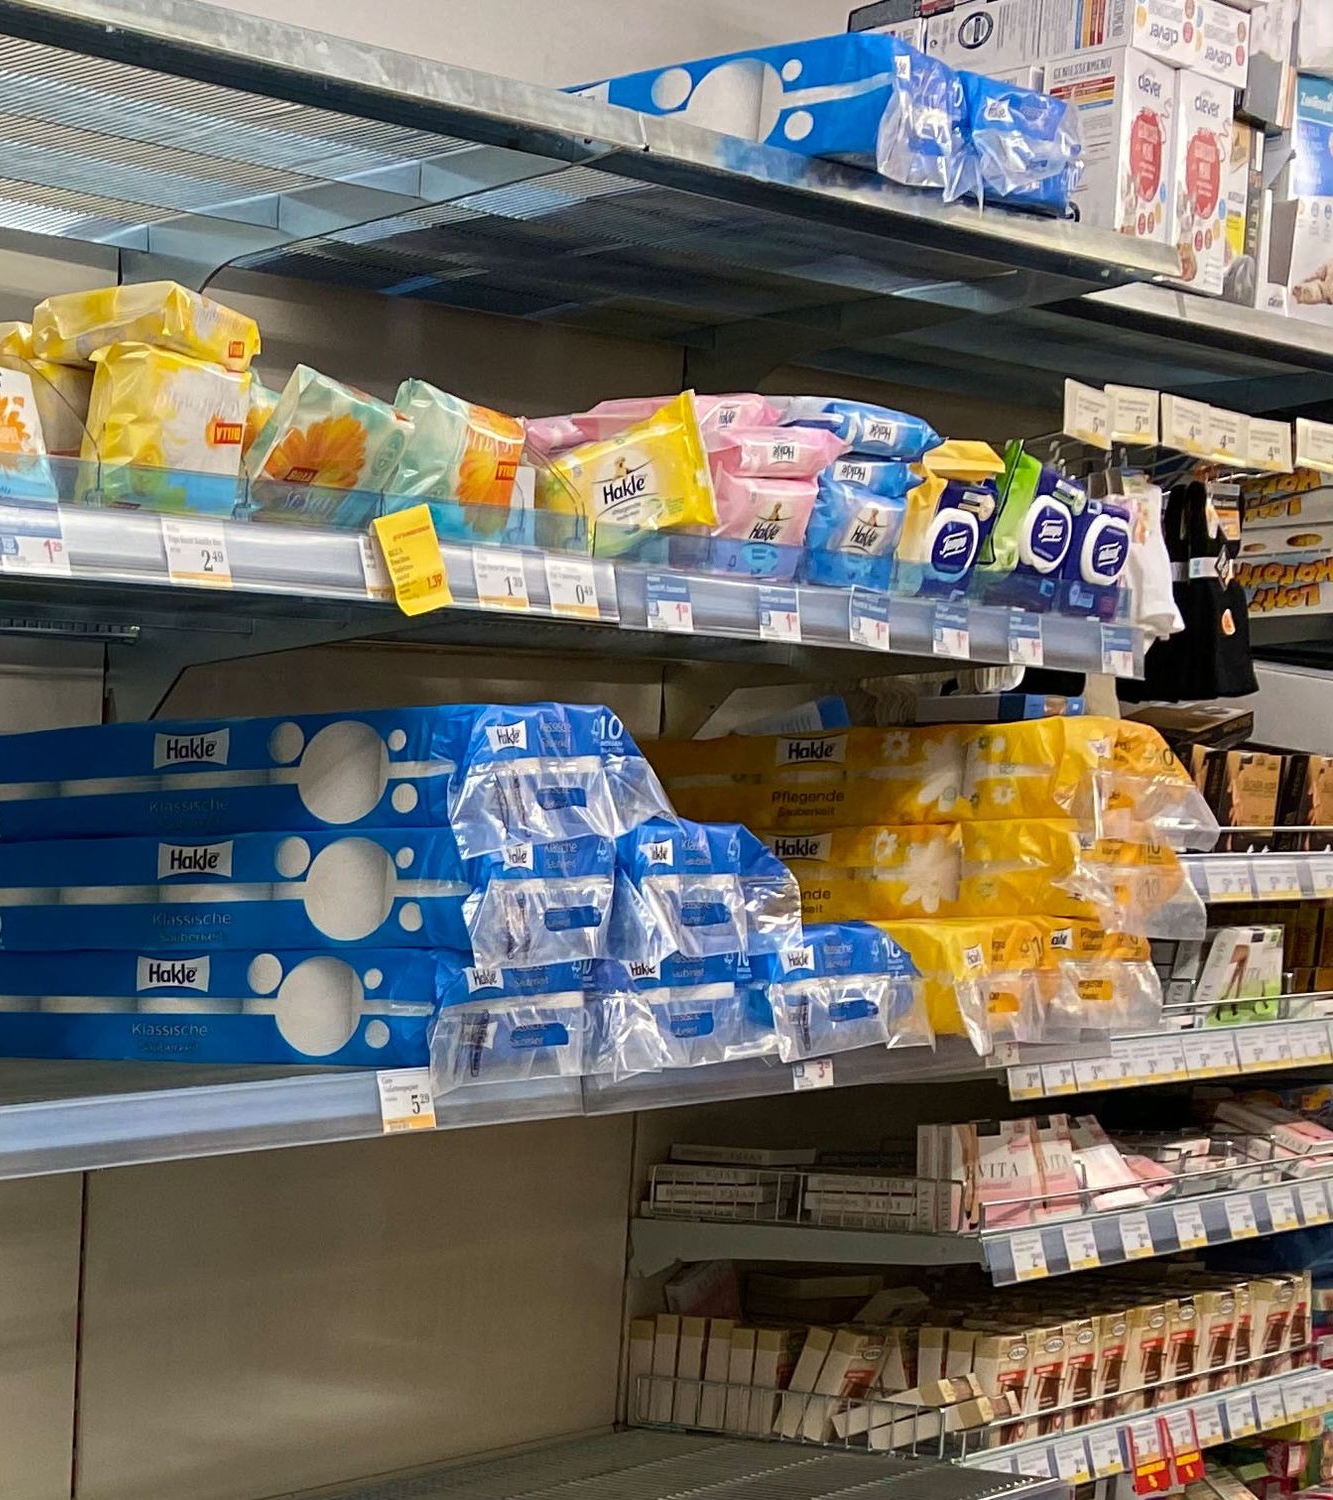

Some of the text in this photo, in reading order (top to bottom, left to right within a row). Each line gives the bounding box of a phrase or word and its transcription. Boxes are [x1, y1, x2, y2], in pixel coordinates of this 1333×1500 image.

[1137, 72, 1162, 99] clever
[1194, 94, 1220, 119] clever
[602, 474, 647, 505] Hakle
[748, 521, 781, 543] Hakle
[851, 525, 879, 548] Hakle
[166, 736, 216, 761] Hakle
[787, 740, 834, 760] Hakle
[150, 797, 229, 814] Klassische
[771, 789, 845, 805] Pflegende
[774, 838, 820, 857] Hakle
[170, 849, 220, 872] Hakle
[152, 912, 232, 926] Klassische
[149, 961, 198, 985] Hakle
[475, 967, 499, 986] Hakle
[132, 1022, 208, 1038] Klassische
